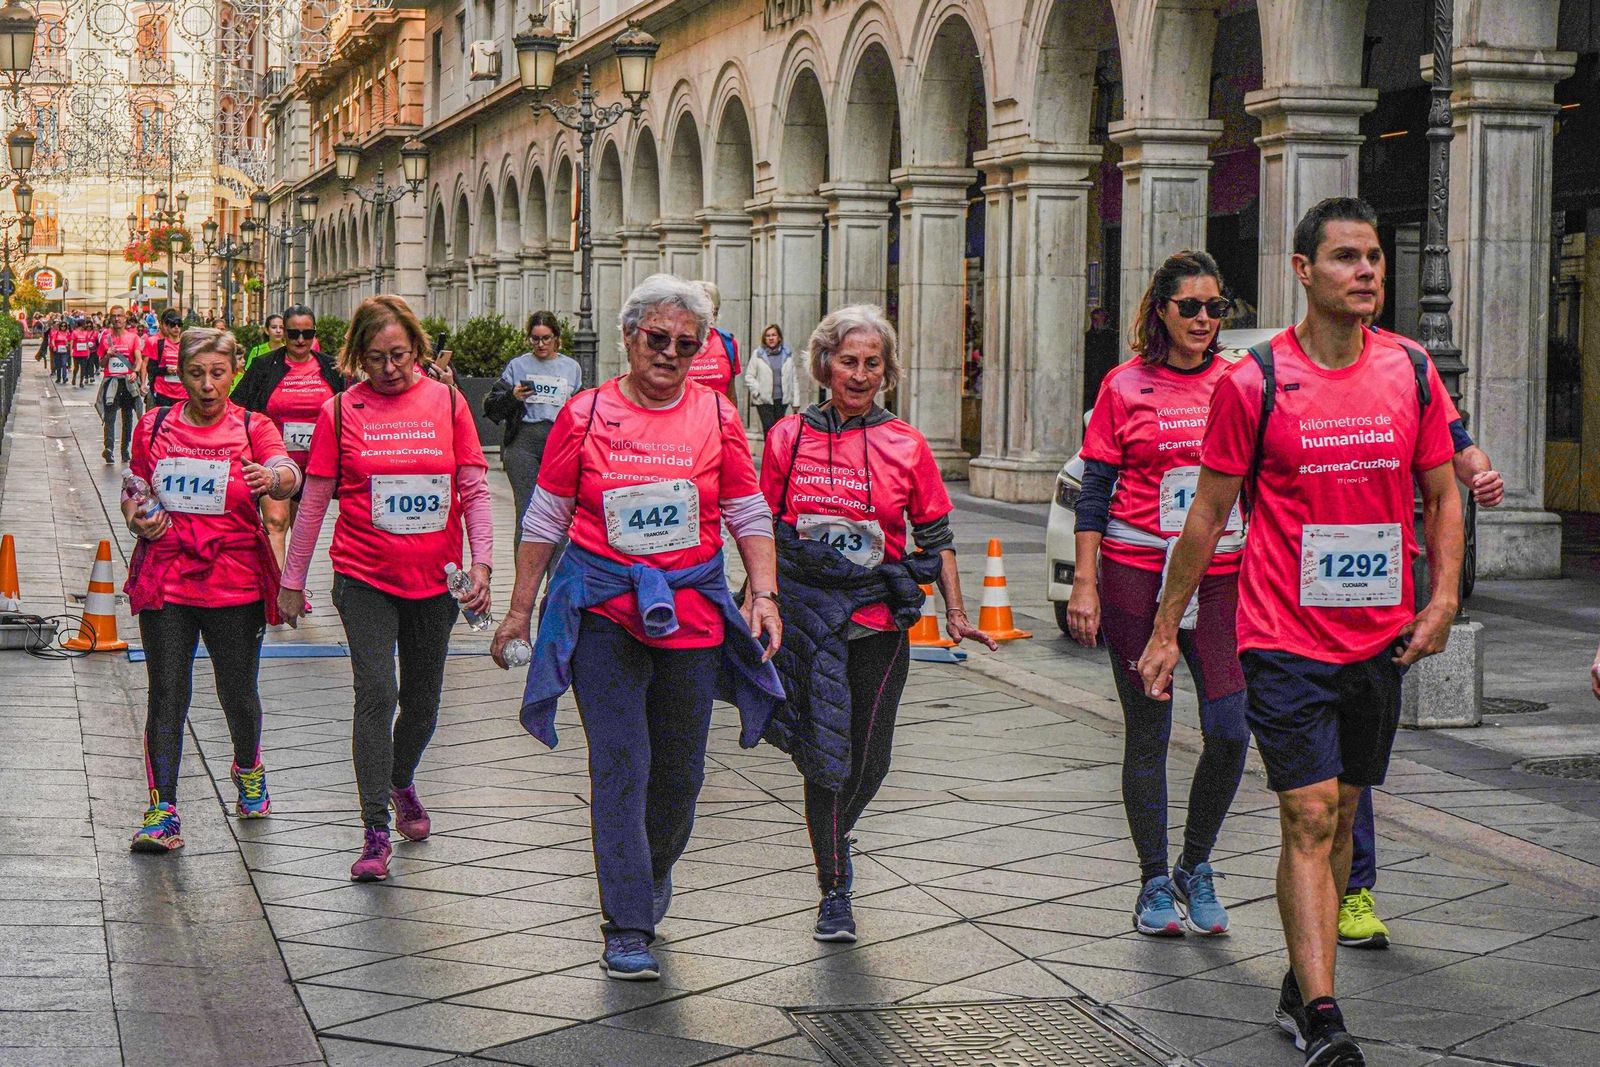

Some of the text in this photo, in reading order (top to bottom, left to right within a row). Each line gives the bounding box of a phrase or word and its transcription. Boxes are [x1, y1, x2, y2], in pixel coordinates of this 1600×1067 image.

[1156, 405, 1210, 418] kilómetro
[421, 419, 434, 428] de
[1159, 416, 1208, 431] humani
[1300, 413, 1392, 431] kilómetros de
[363, 429, 436, 441] humanidad
[1302, 429, 1394, 449] humanidad
[217, 447, 231, 456] de
[361, 447, 443, 457] #CarreraCruzRoja
[677, 443, 692, 453] de
[1157, 440, 1204, 451] #Carrera
[609, 452, 693, 467] humanidad
[1299, 457, 1400, 475] #CarreraCruzRoja
[162, 475, 215, 494] 1114
[796, 474, 873, 491] humanidad
[385, 494, 440, 513] 1093
[792, 493, 876, 513] #CarreraCruzRoja
[628, 505, 680, 529] 442
[820, 532, 863, 551] 443
[1319, 553, 1388, 578] 1292
